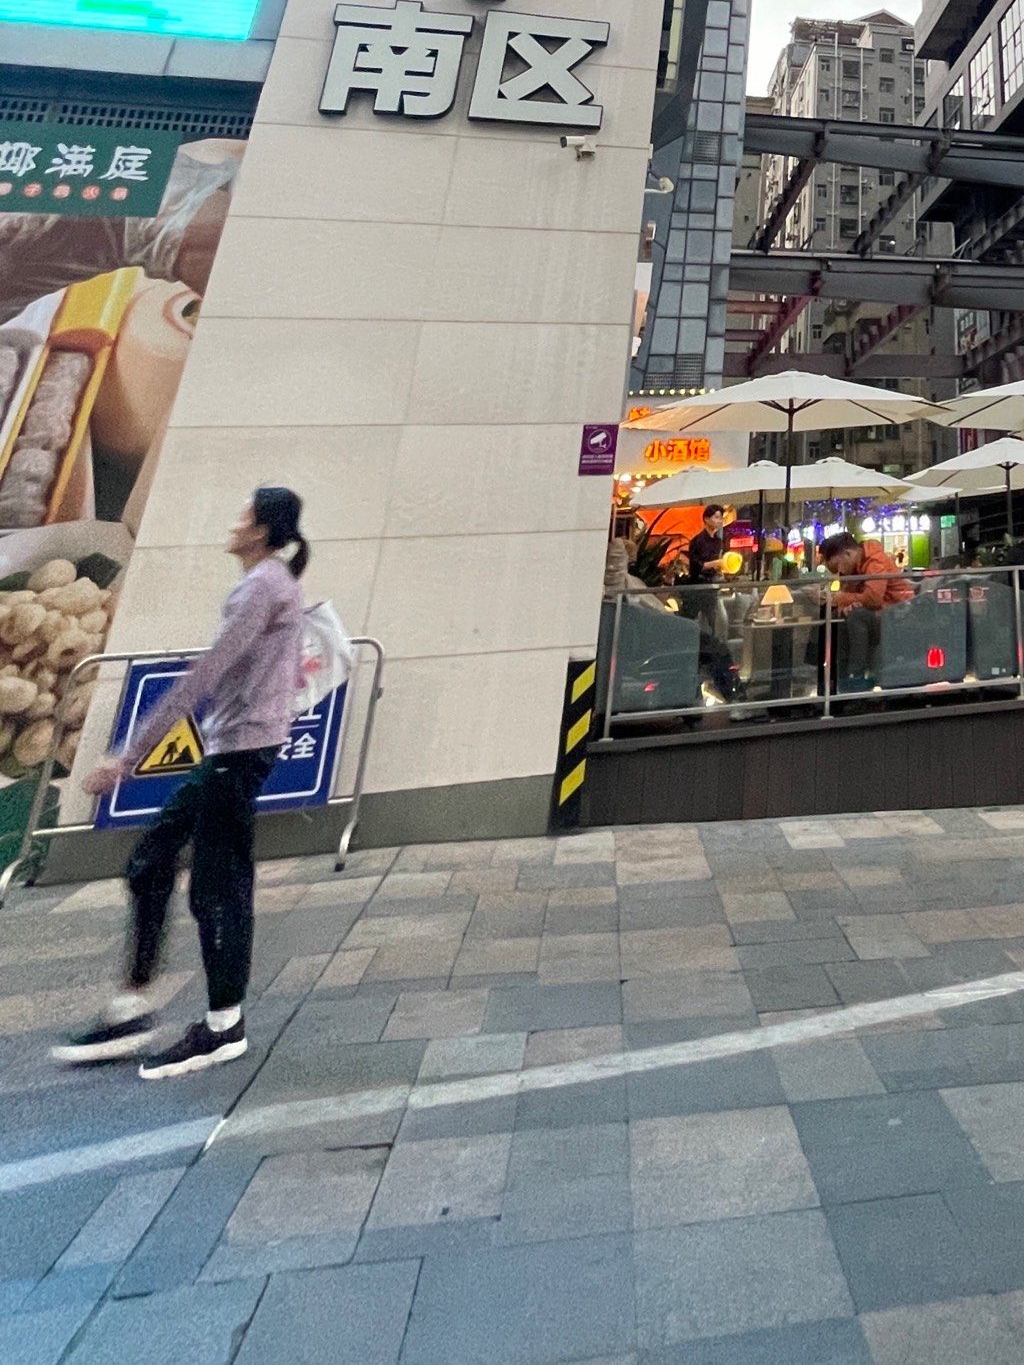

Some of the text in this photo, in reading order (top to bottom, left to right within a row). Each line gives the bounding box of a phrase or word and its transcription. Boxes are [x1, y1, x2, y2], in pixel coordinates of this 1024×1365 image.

[318, 0, 611, 129] 南区
[645, 437, 710, 463] 小酒馆
